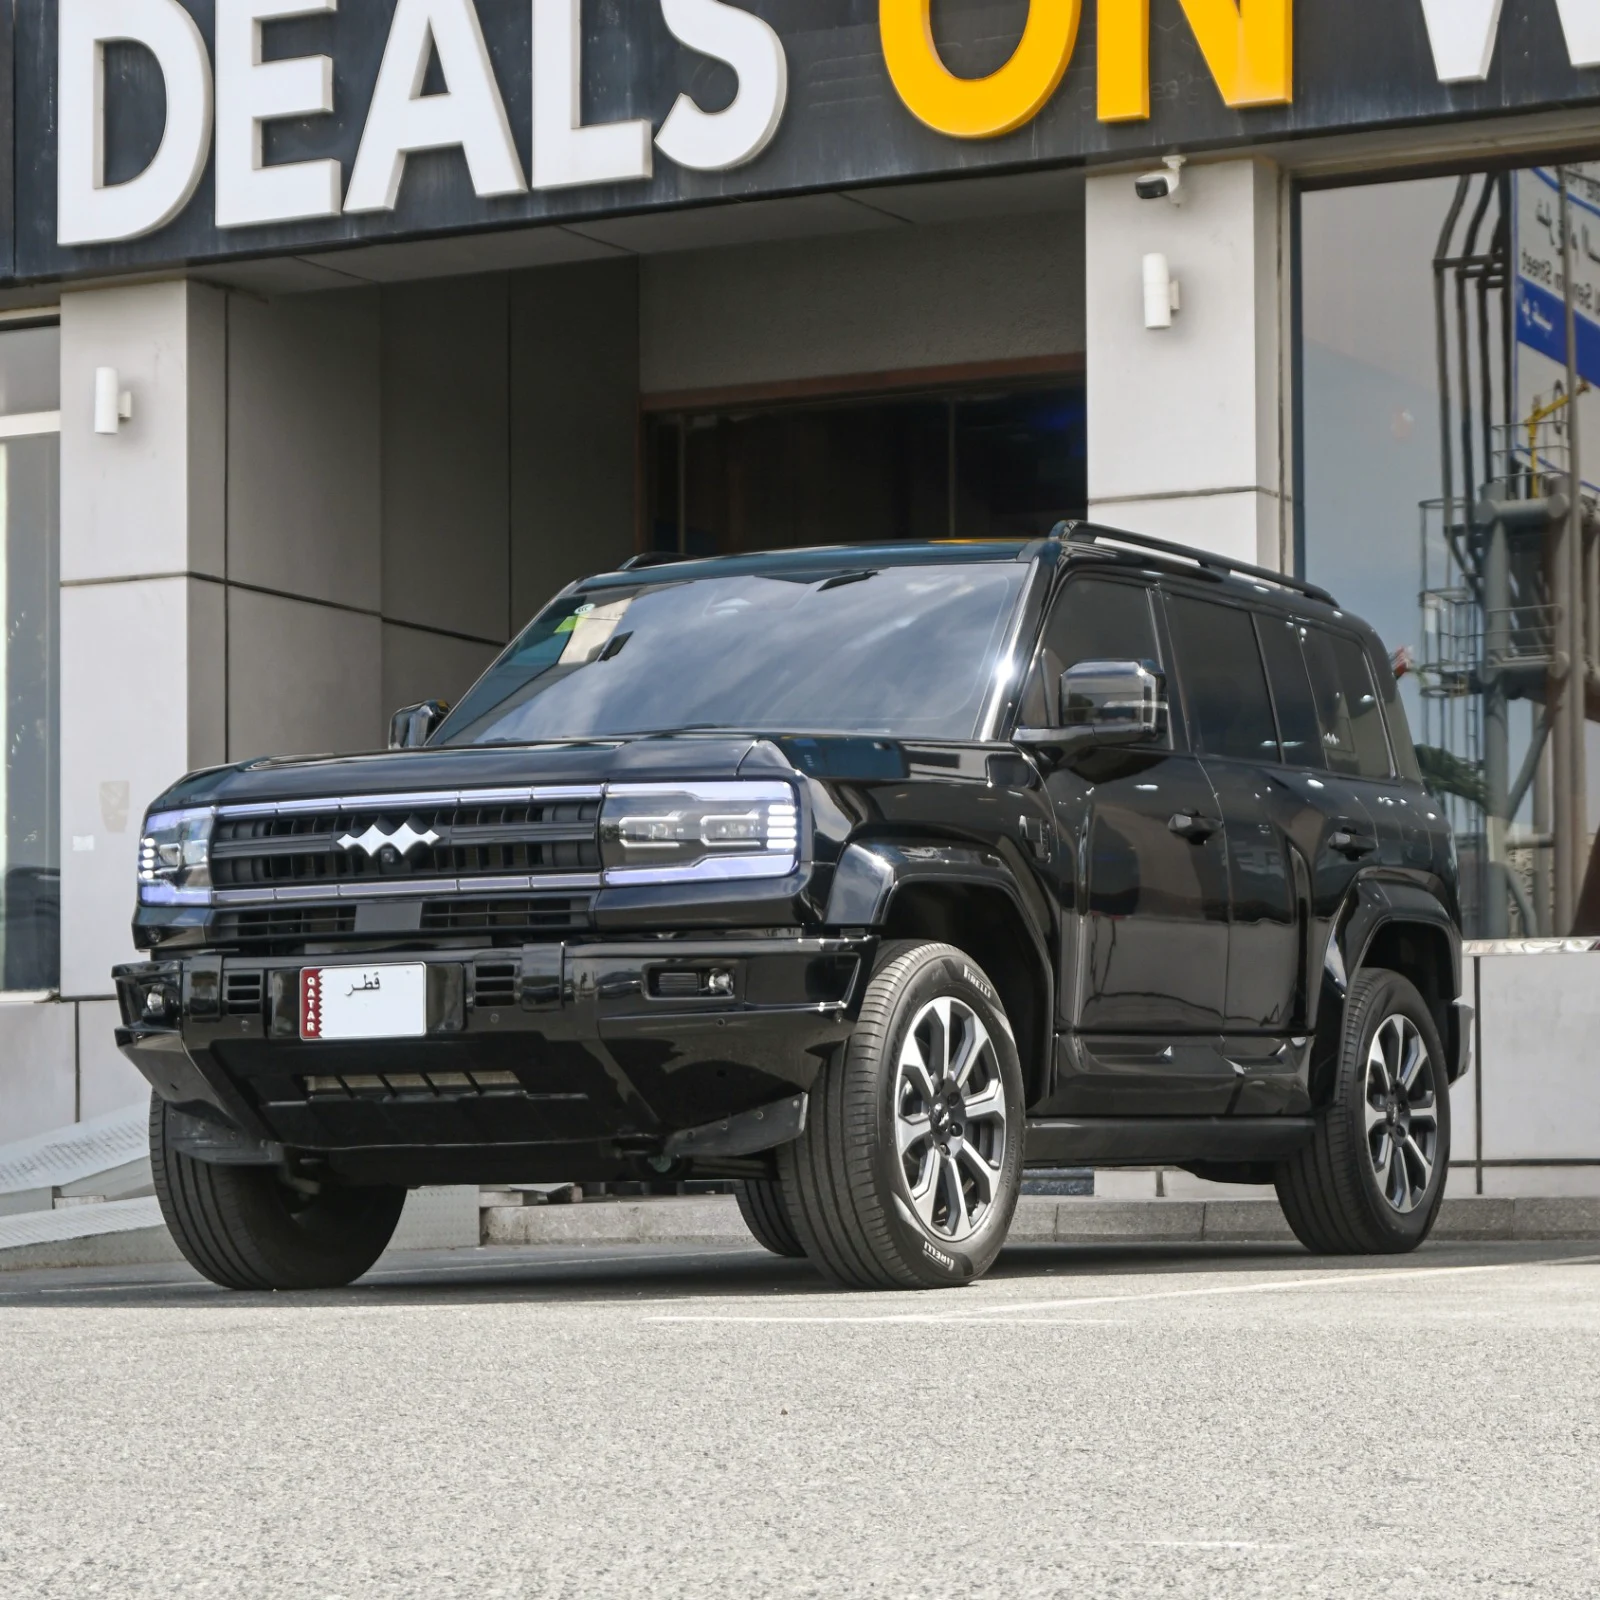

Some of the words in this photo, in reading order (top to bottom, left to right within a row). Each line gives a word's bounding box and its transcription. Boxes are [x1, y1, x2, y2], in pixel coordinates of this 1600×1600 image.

[57, 0, 787, 246] DEALS
[306, 976, 316, 1032] QATAR
[345, 971, 381, 997] قطر
[922, 1240, 955, 1271] PIRELLI
